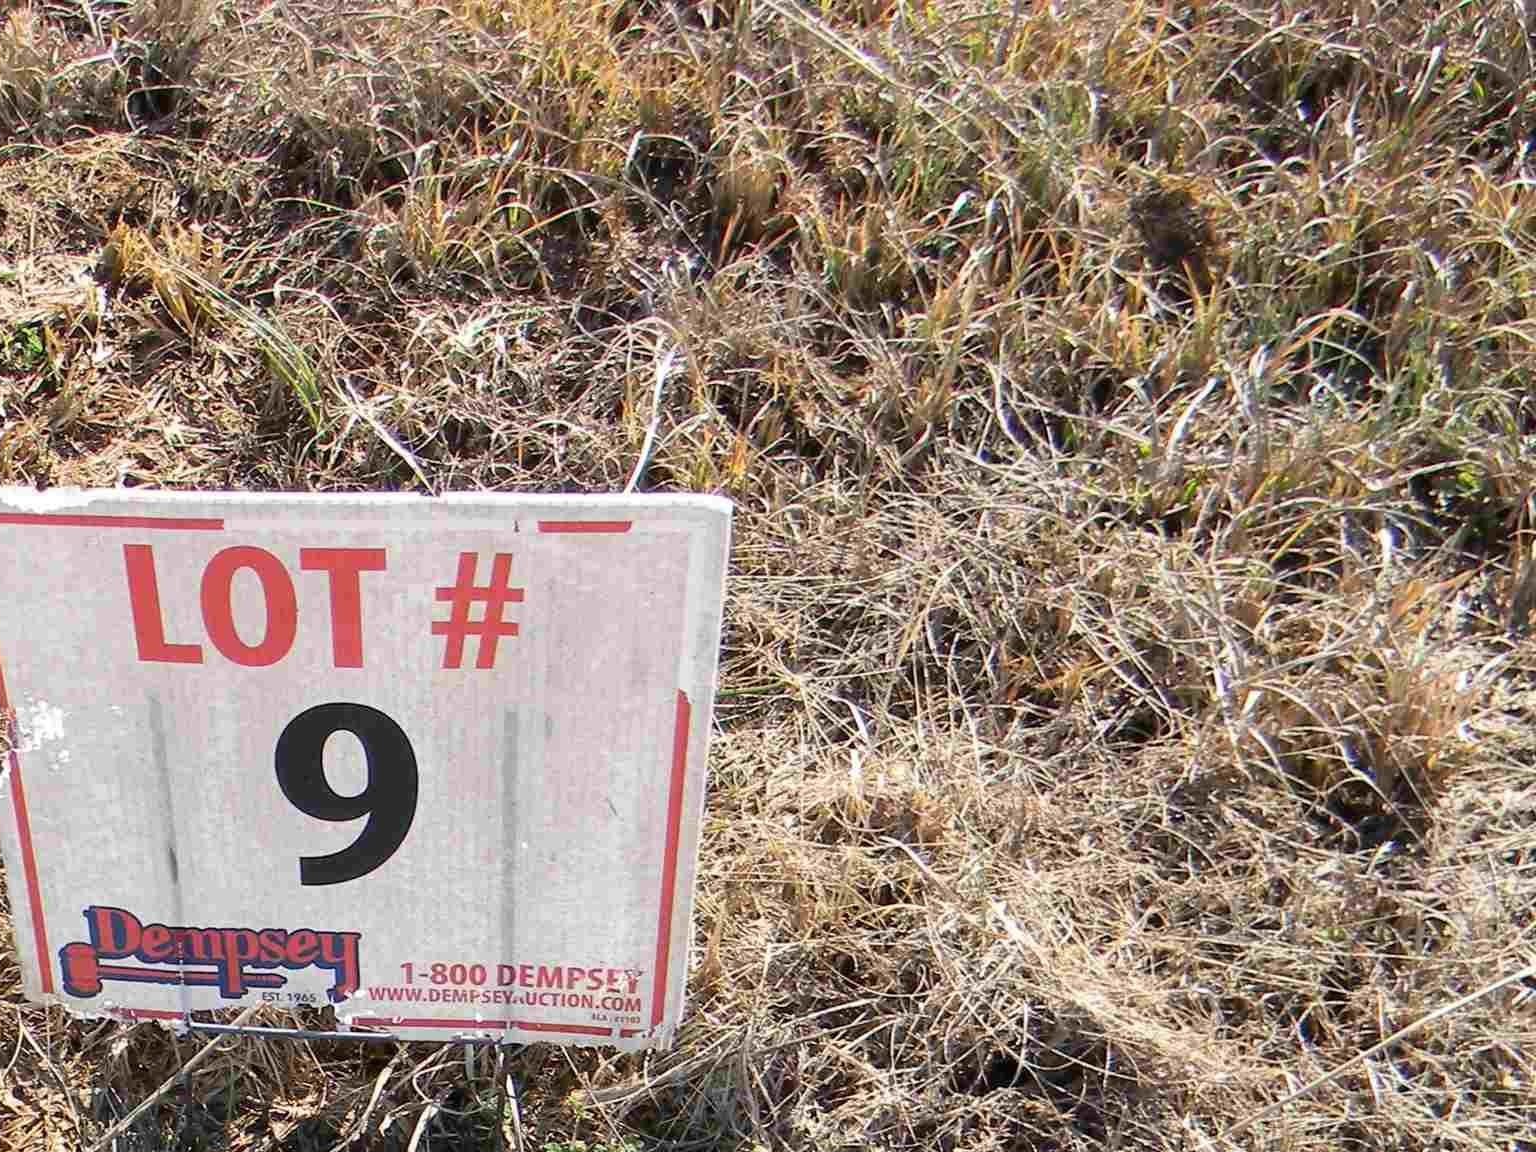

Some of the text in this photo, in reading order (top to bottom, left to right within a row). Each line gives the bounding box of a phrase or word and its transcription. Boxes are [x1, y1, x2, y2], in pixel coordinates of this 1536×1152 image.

[123, 544, 525, 669] LOT #
[274, 702, 419, 886] 9
[83, 906, 362, 1002] Dempsey
[287, 991, 317, 1002] 1965
[400, 962, 644, 994] 1-800 DEMPSEY
